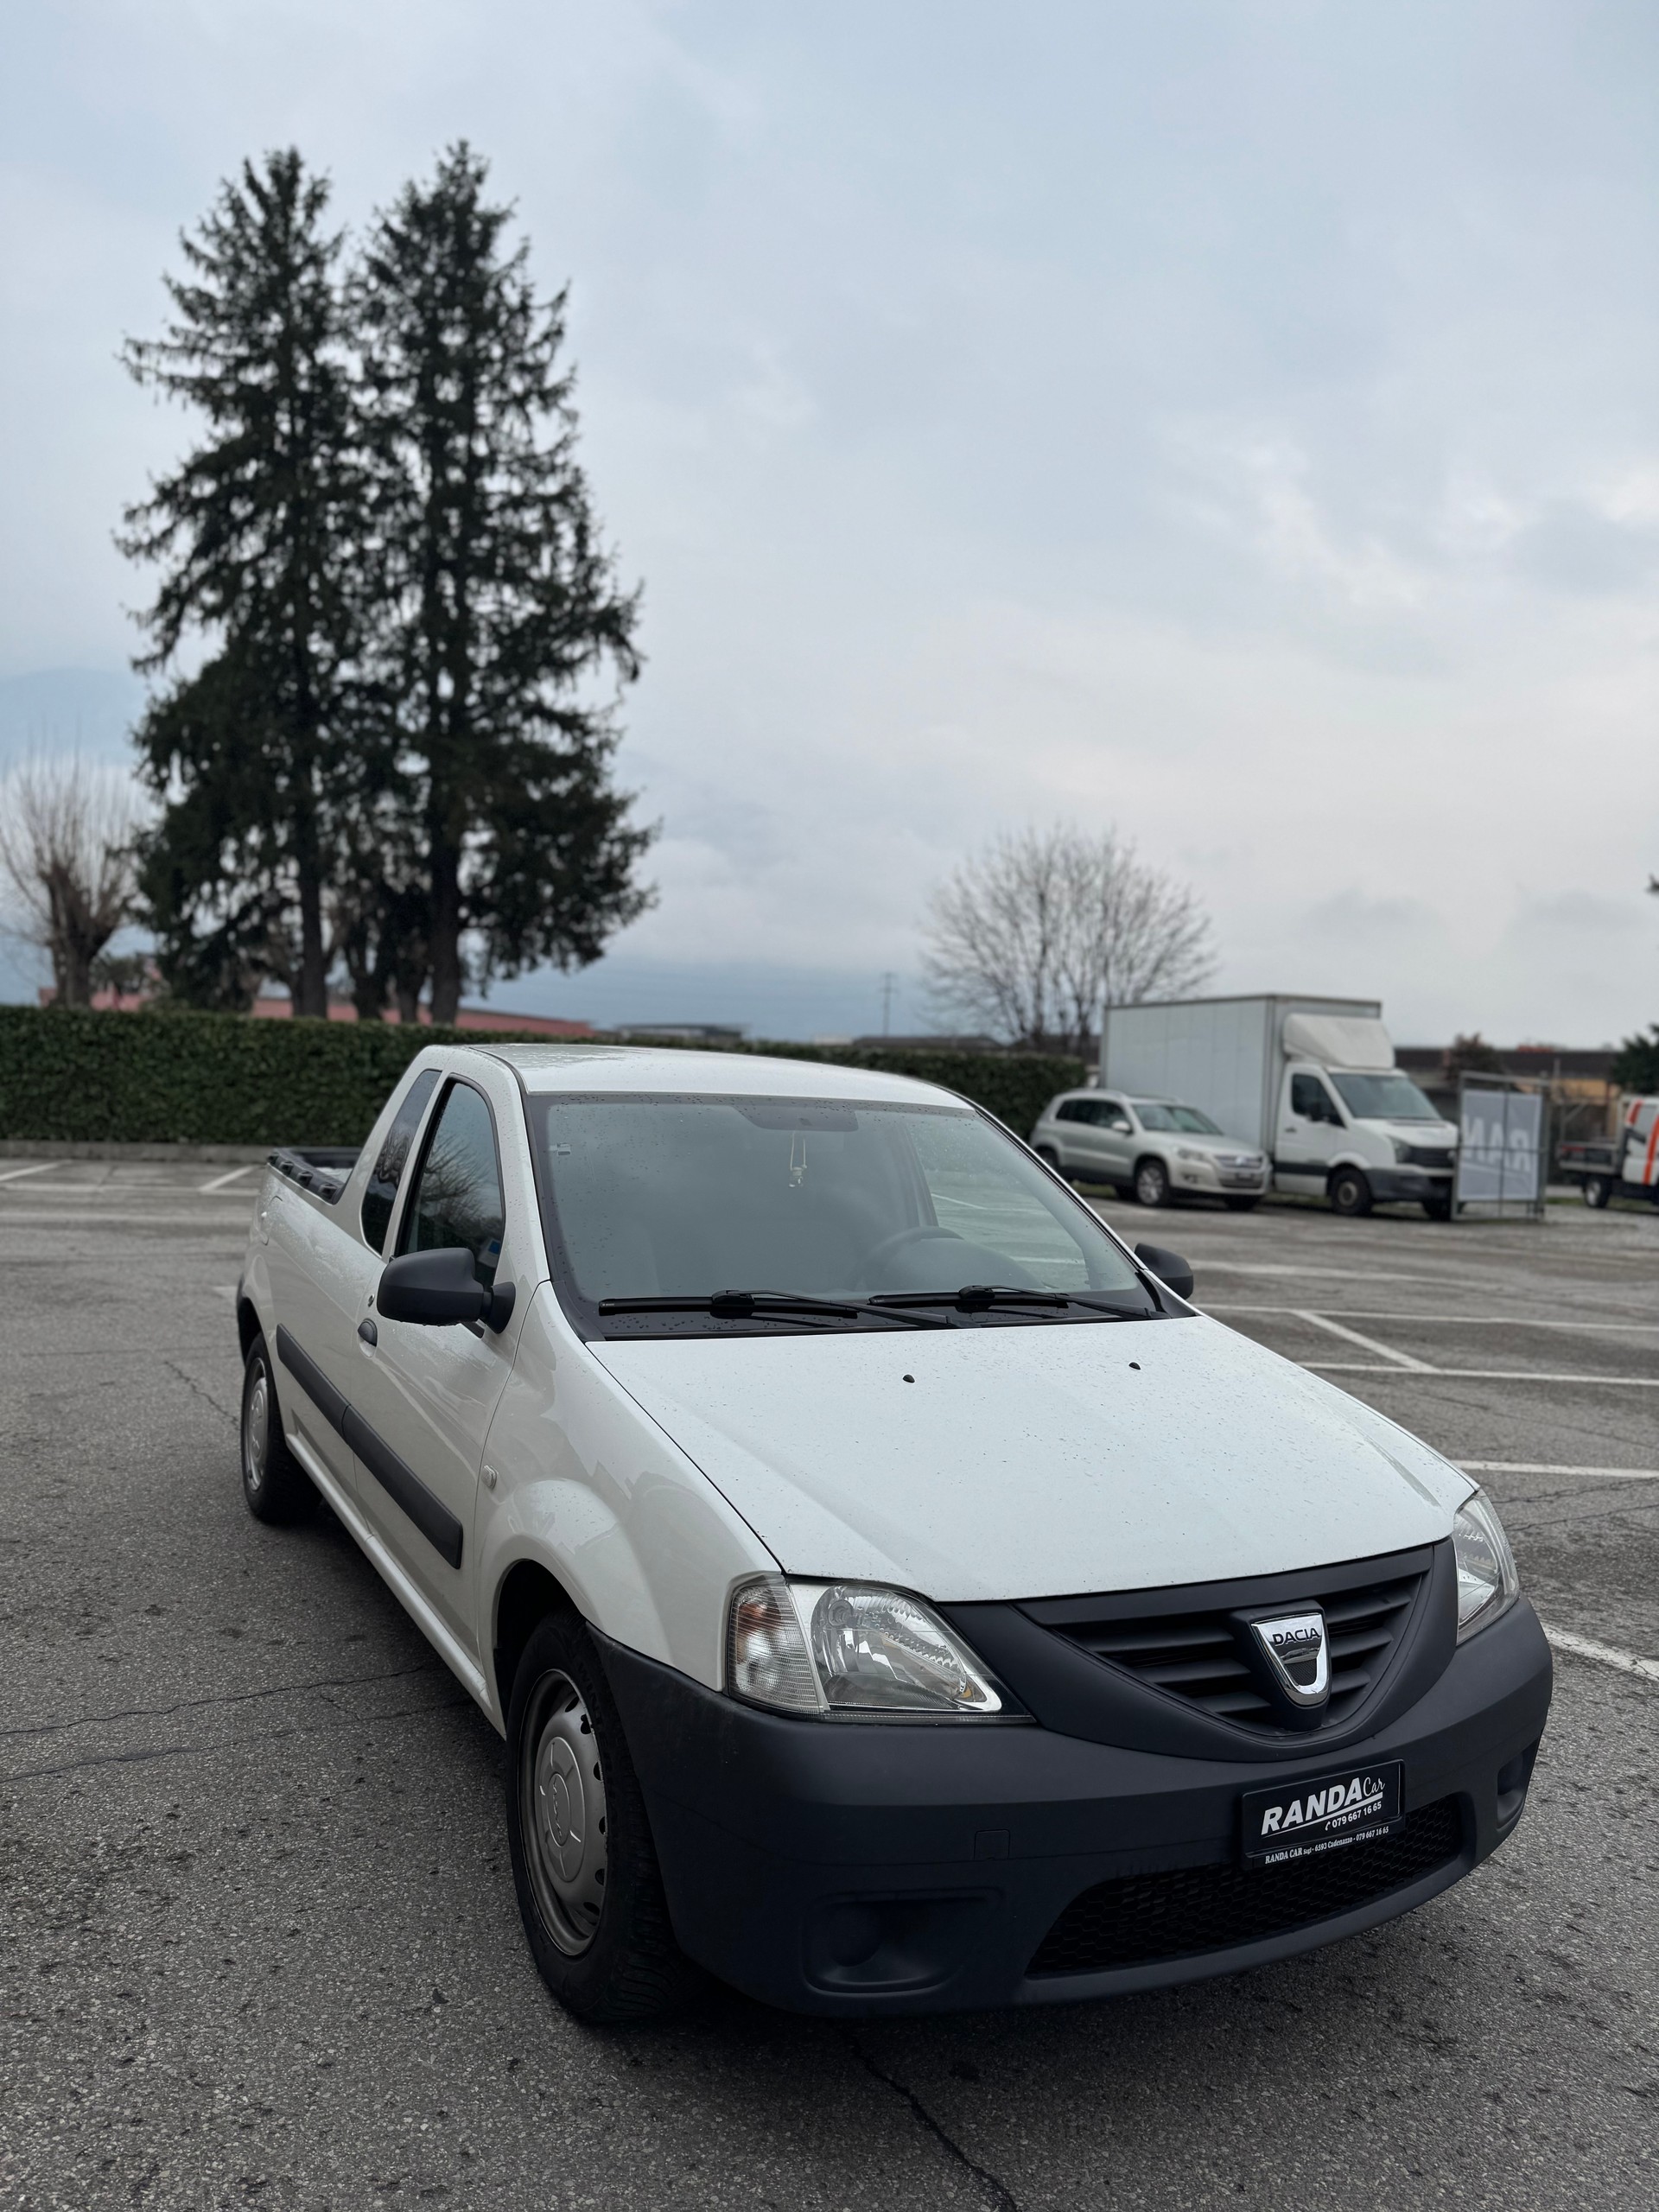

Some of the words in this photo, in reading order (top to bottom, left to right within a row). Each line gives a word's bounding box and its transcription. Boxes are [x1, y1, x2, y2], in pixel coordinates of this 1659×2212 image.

[1272, 1627, 1320, 1645] DACIA
[1261, 1777, 1363, 1835] RANDA
[1363, 1777, 1386, 1797] Car
[1332, 1815, 1346, 1828] 079
[1347, 1809, 1362, 1822] 667
[1363, 1806, 1372, 1815] 16
[1372, 1801, 1382, 1811] 65
[1265, 1851, 1289, 1865] RANDA
[1289, 1847, 1303, 1859] CAR
[1314, 1842, 1327, 1852] 6593
[1356, 1832, 1365, 1841] 079
[1365, 1829, 1376, 1839] 667
[1376, 1827, 1382, 1836] 16
